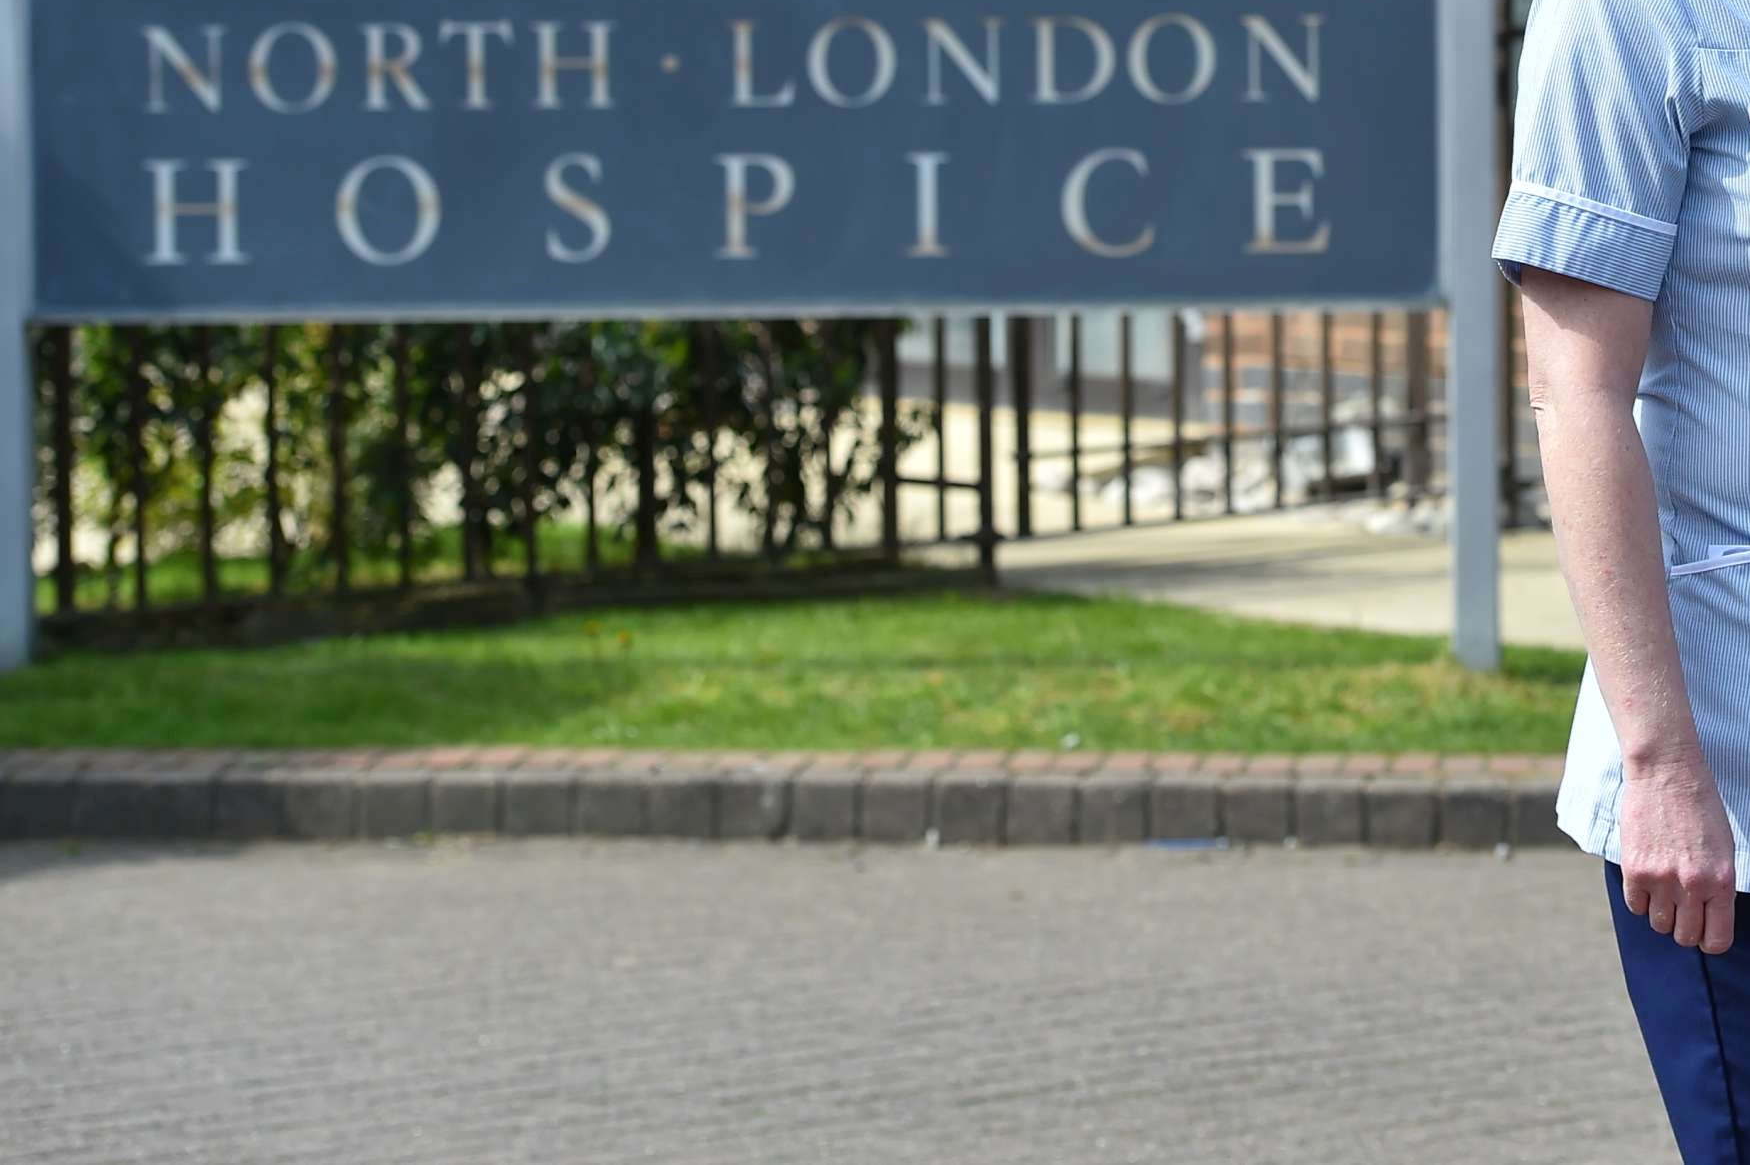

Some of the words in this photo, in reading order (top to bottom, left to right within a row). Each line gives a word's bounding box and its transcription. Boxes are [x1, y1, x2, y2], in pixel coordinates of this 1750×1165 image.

[144, 20, 615, 113] NORTH
[728, 13, 1325, 107] LONDON
[144, 146, 1332, 266] HOSPICE
